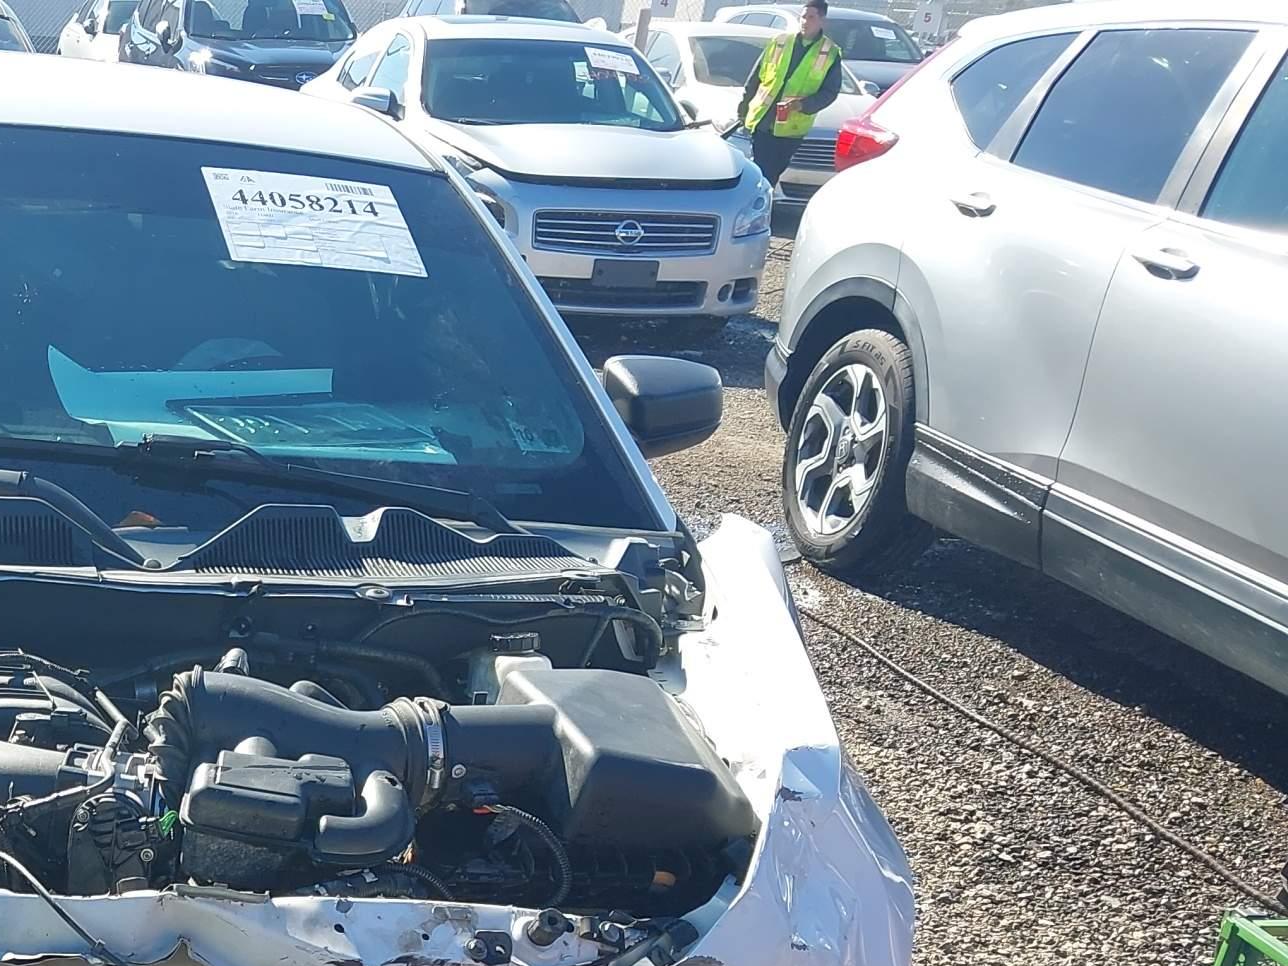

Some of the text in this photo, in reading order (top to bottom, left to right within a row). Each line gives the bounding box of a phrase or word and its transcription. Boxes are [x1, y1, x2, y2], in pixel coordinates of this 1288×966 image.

[924, 12, 932, 23] 5
[231, 189, 379, 218] 44058214
[853, 340, 861, 349] S
[861, 341, 877, 353] FIT
